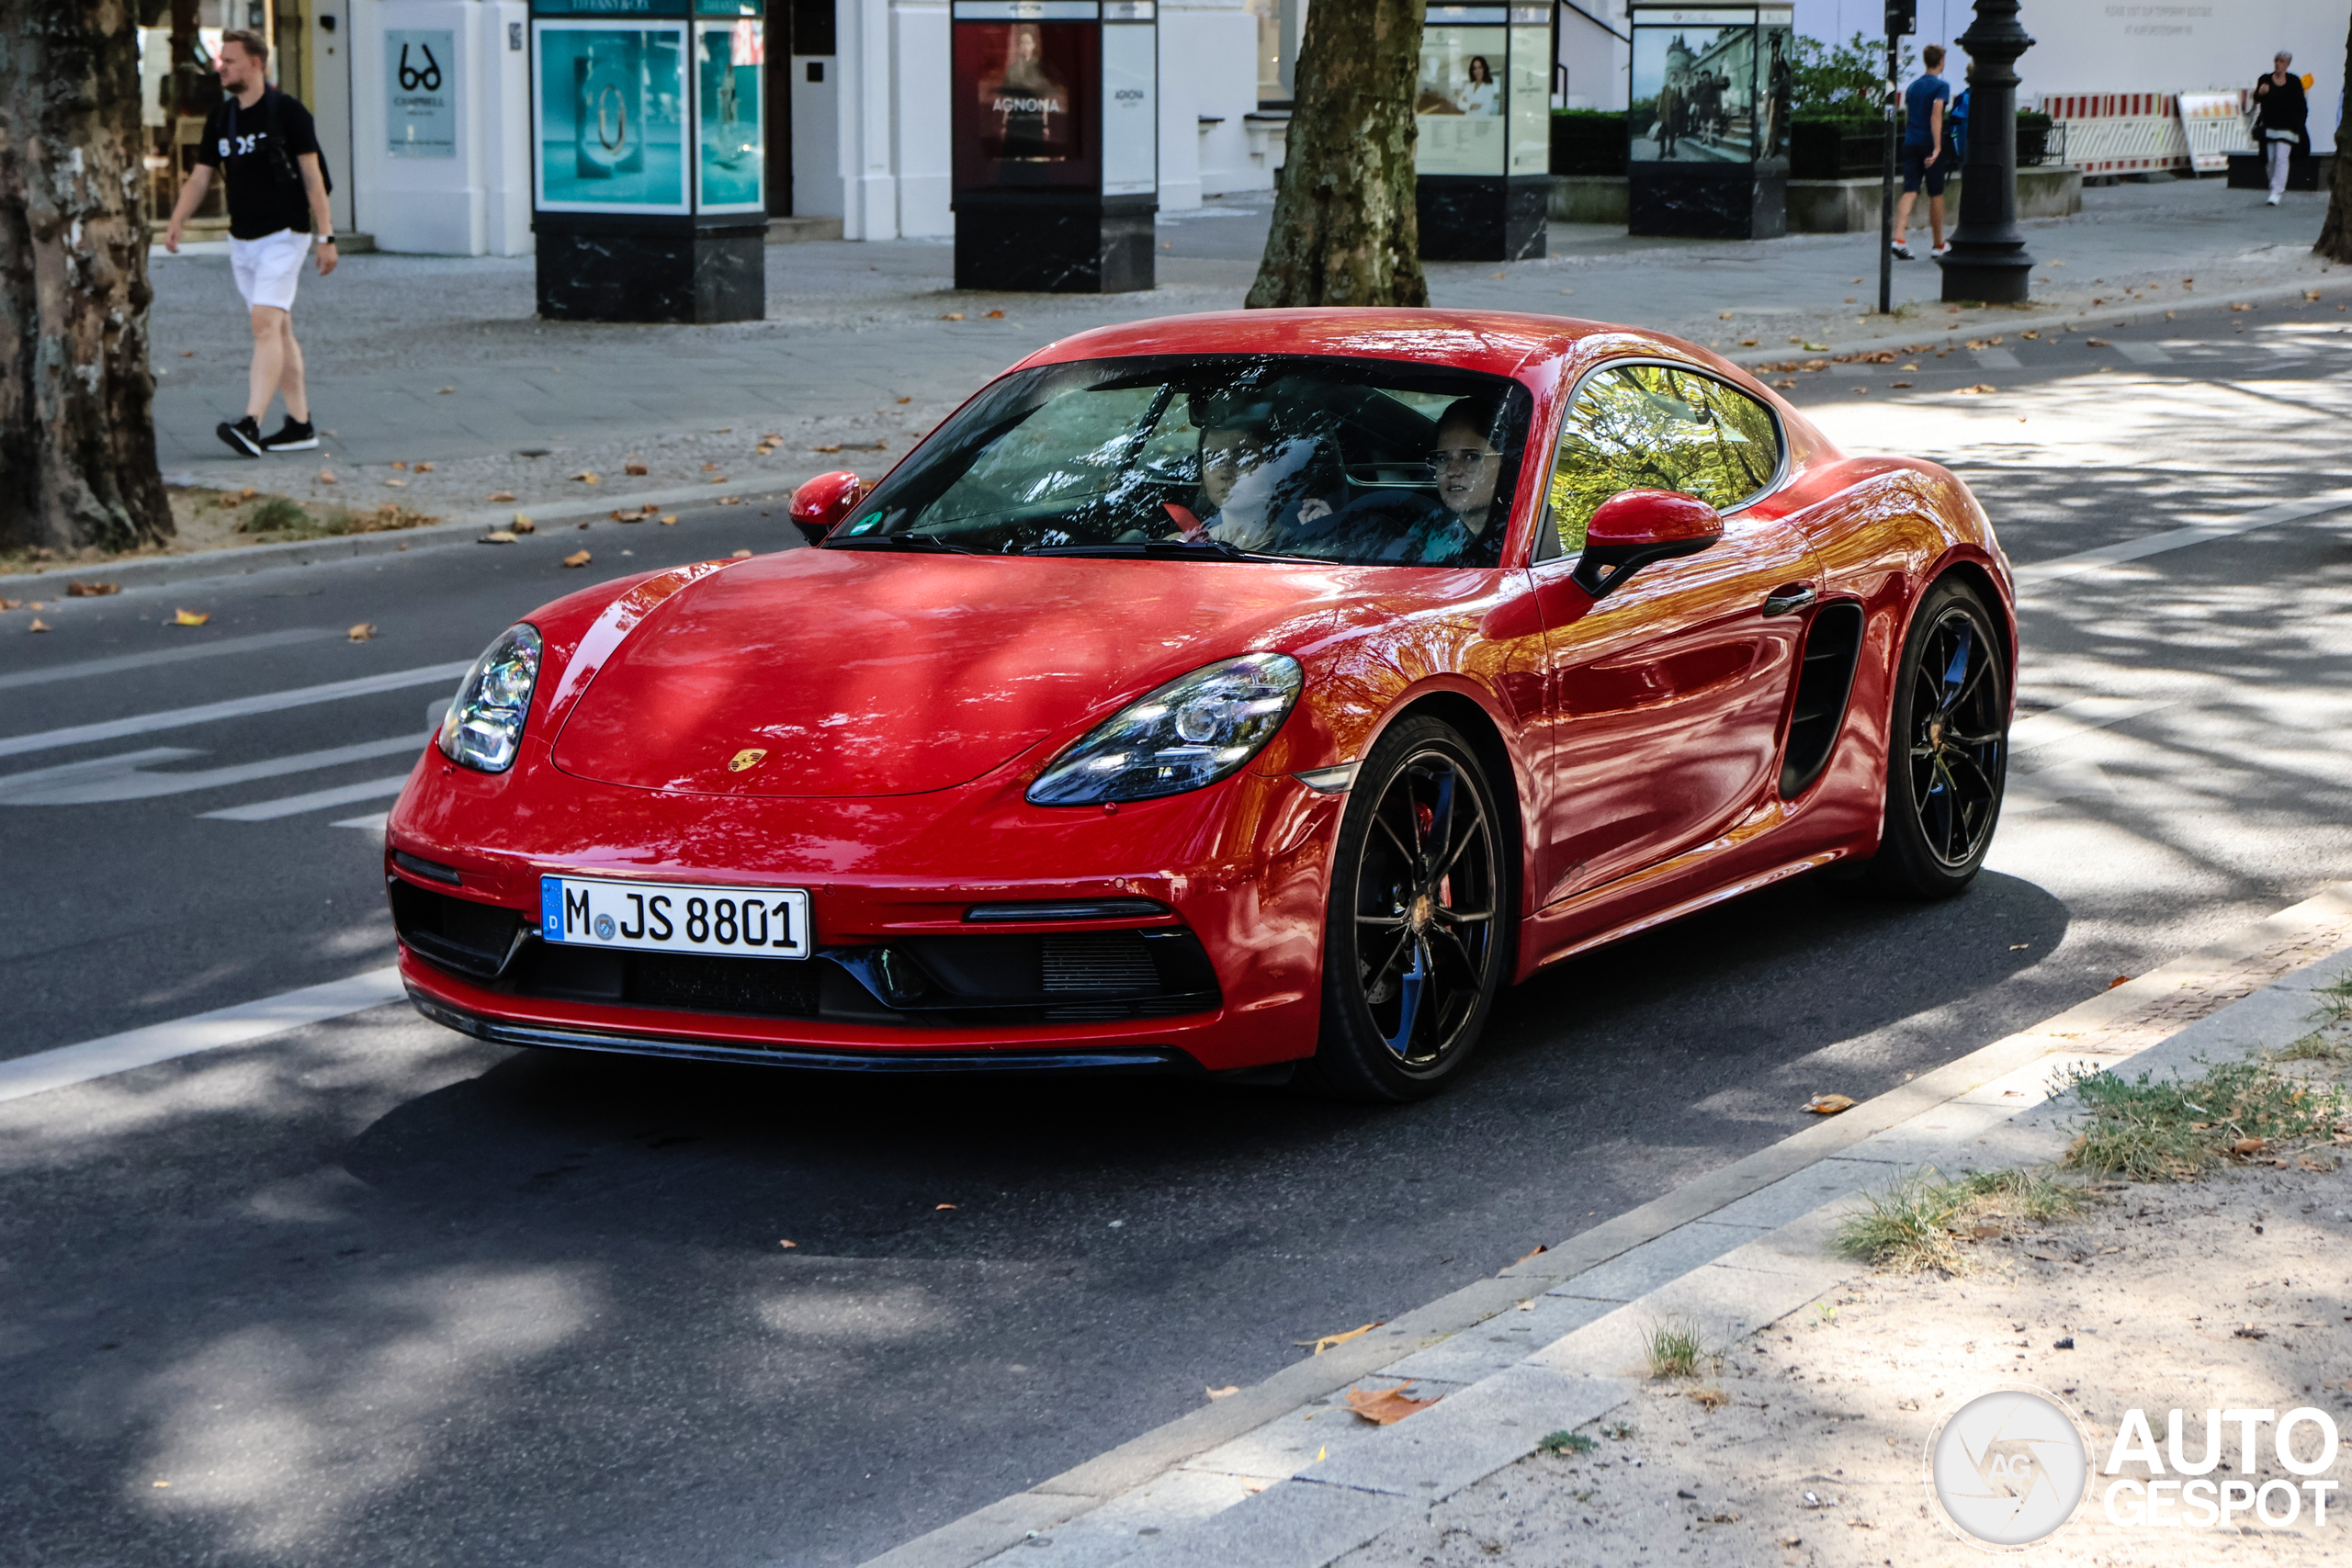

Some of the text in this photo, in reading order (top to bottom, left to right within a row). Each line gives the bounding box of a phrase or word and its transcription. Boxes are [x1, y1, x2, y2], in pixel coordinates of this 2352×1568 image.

[992, 97, 1060, 113] AGNONA
[218, 131, 268, 157] BOS
[548, 914, 559, 930] D
[565, 887, 798, 948] M JS 8801
